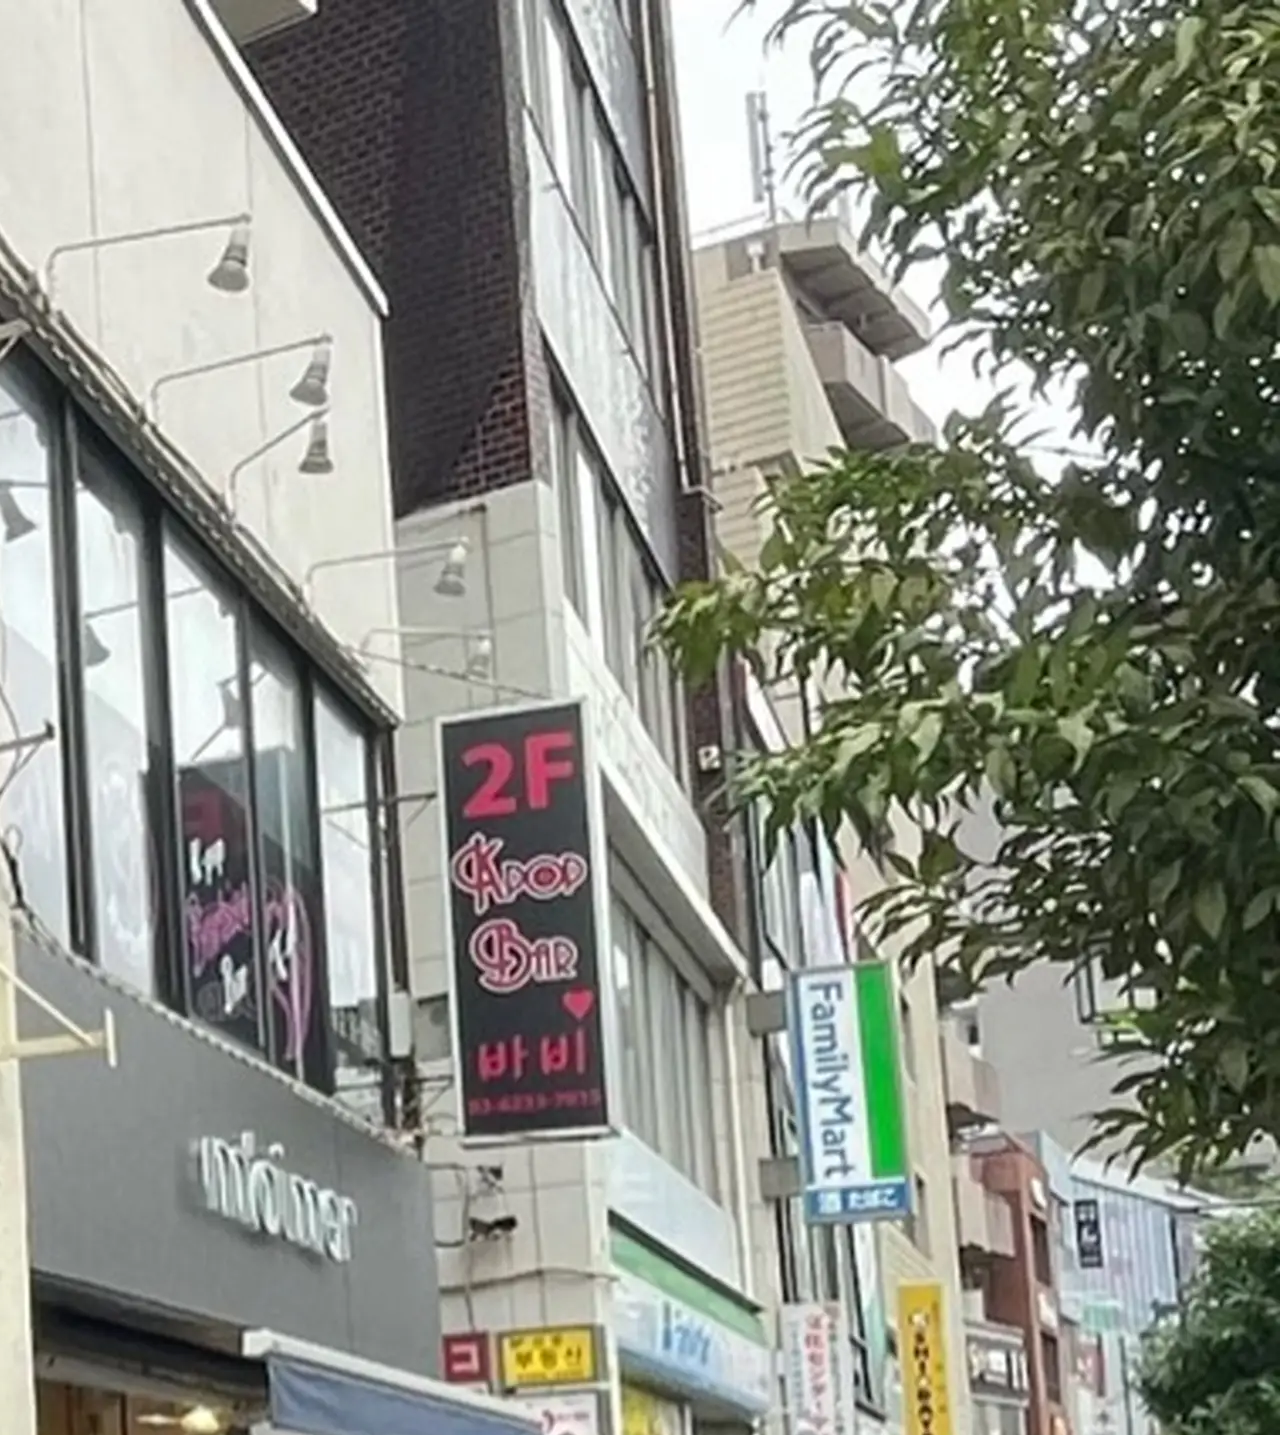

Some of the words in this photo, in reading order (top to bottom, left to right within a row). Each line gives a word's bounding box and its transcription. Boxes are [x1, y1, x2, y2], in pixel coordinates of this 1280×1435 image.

[462, 733, 574, 817] 2F
[478, 1026, 586, 1082] 바비
[809, 982, 855, 1179] FamilyMart
